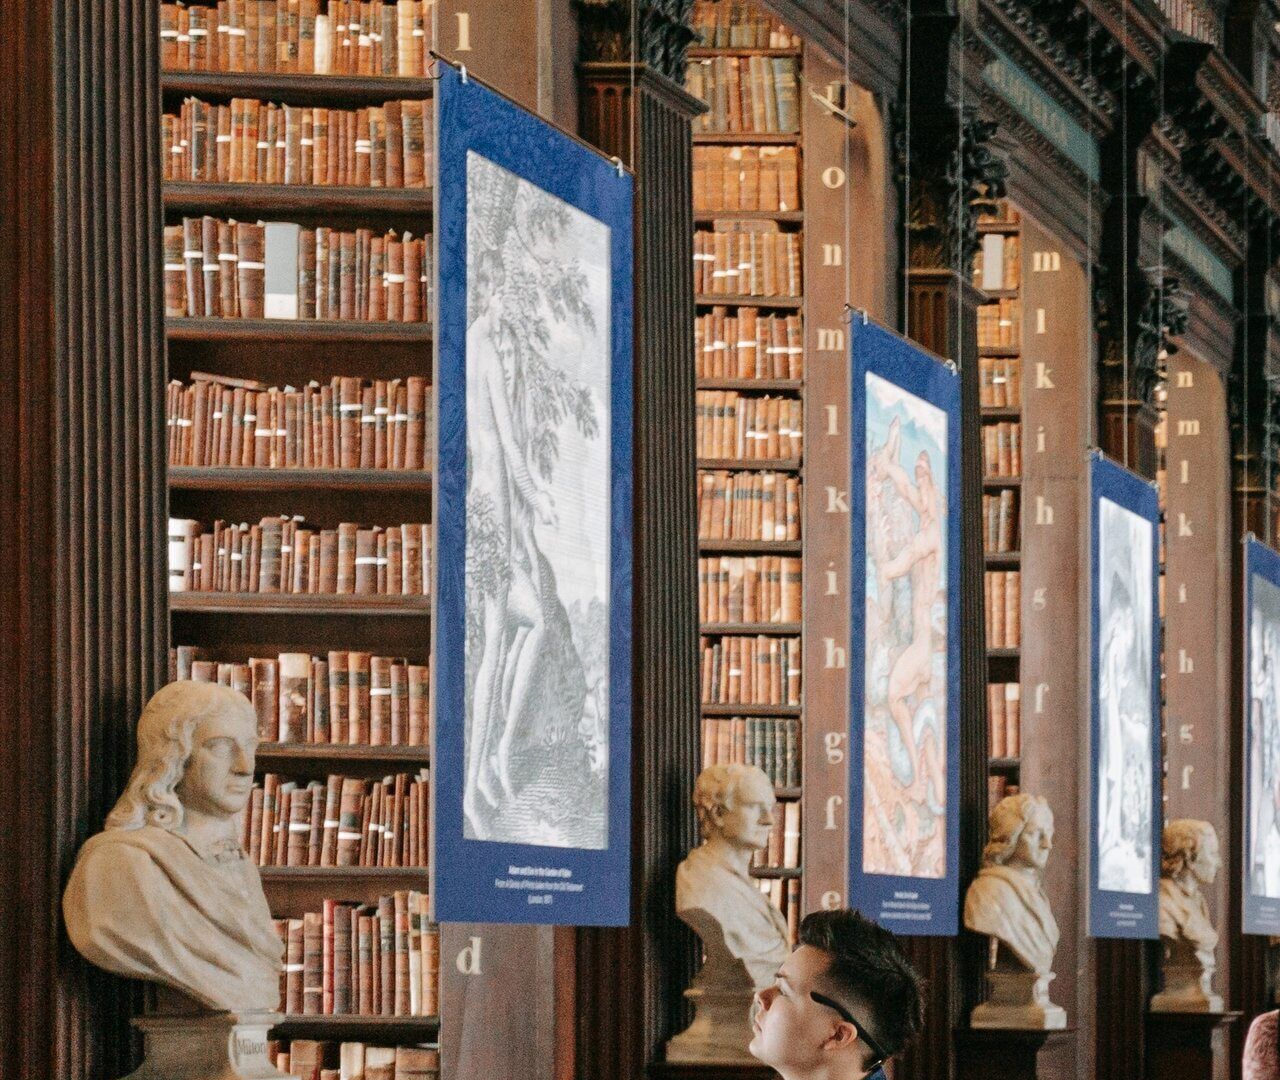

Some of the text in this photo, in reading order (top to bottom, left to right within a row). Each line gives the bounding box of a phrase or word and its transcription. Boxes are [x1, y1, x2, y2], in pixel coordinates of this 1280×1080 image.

[456, 13, 471, 50] l
[822, 167, 845, 188] o
[823, 244, 841, 265] n
[1033, 252, 1060, 271] m
[1037, 309, 1045, 333] l
[818, 329, 843, 350] m
[1036, 362, 1054, 388] k
[1177, 372, 1193, 387] n
[826, 405, 837, 435] l
[1178, 420, 1199, 435] m
[1036, 425, 1045, 452] i
[1181, 460, 1188, 483] l
[826, 487, 849, 512] k
[1036, 496, 1053, 524] h
[1179, 513, 1192, 536] k
[826, 565, 838, 594] i
[824, 638, 845, 668] h
[1179, 649, 1193, 673] h
[825, 732, 847, 764] g
[456, 937, 481, 974] d
[238, 1038, 266, 1056] Milton
